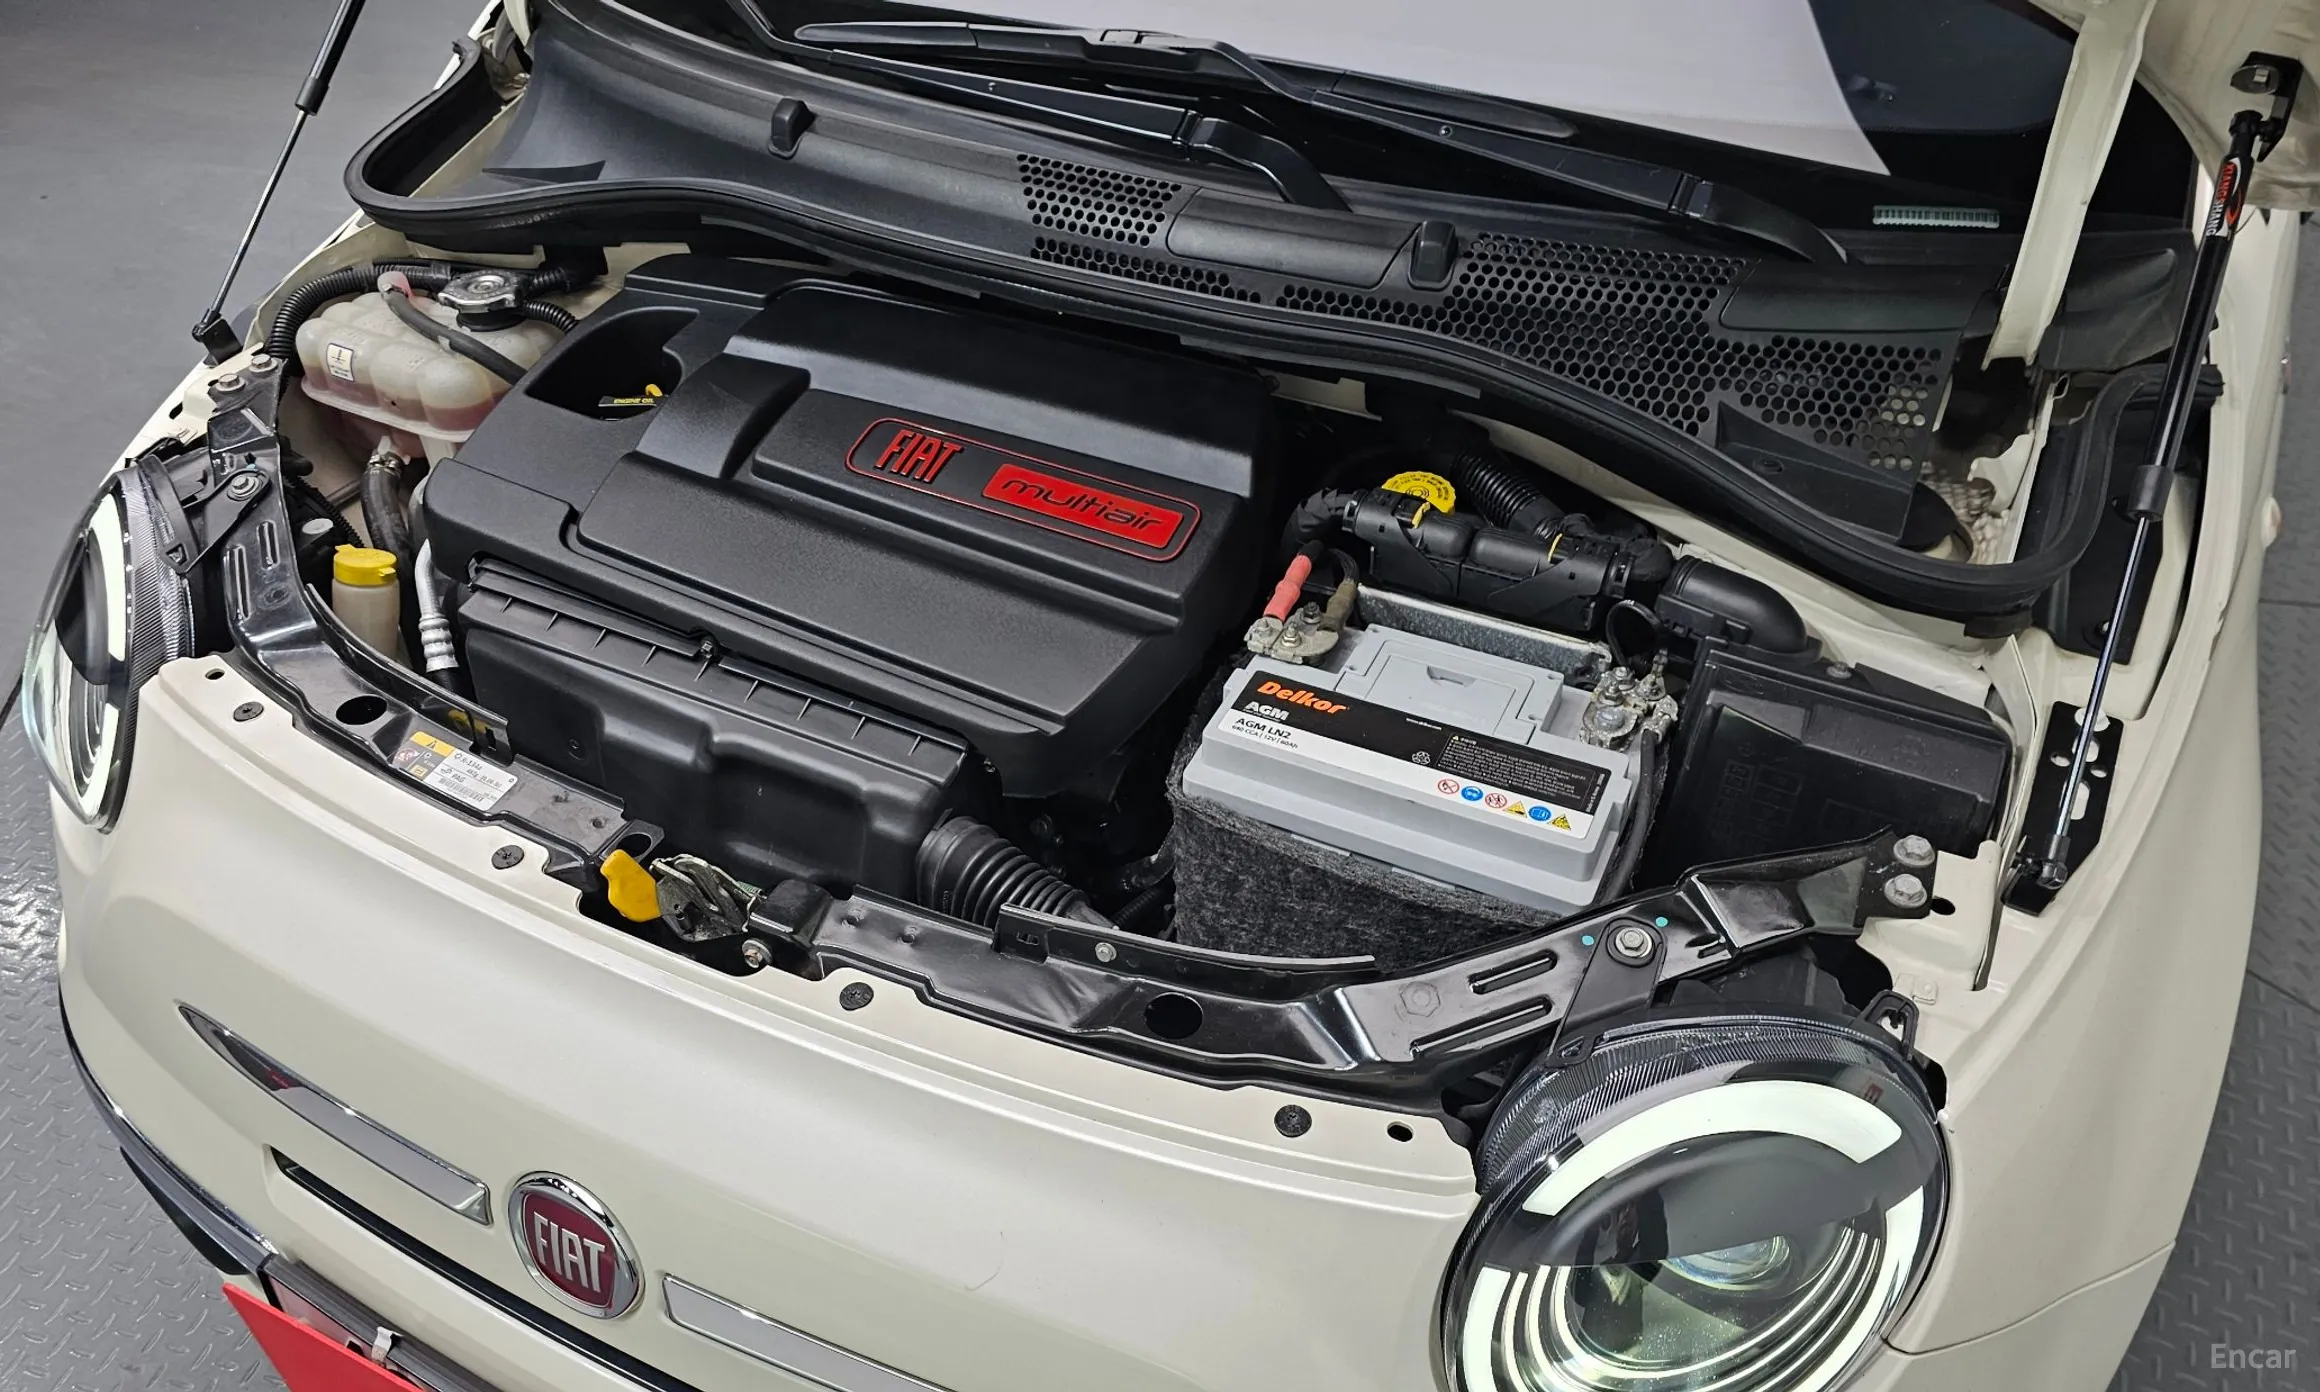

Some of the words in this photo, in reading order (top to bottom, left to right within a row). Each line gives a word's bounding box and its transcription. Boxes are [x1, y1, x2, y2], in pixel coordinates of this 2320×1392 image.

[875, 429, 964, 483] FIAT
[1001, 478, 1163, 531] multiair
[1244, 701, 1290, 721] AGM
[1257, 681, 1347, 714] Delkor
[1236, 718, 1267, 732] AGM
[1268, 726, 1292, 739] LN2
[534, 1211, 605, 1293] FIAT
